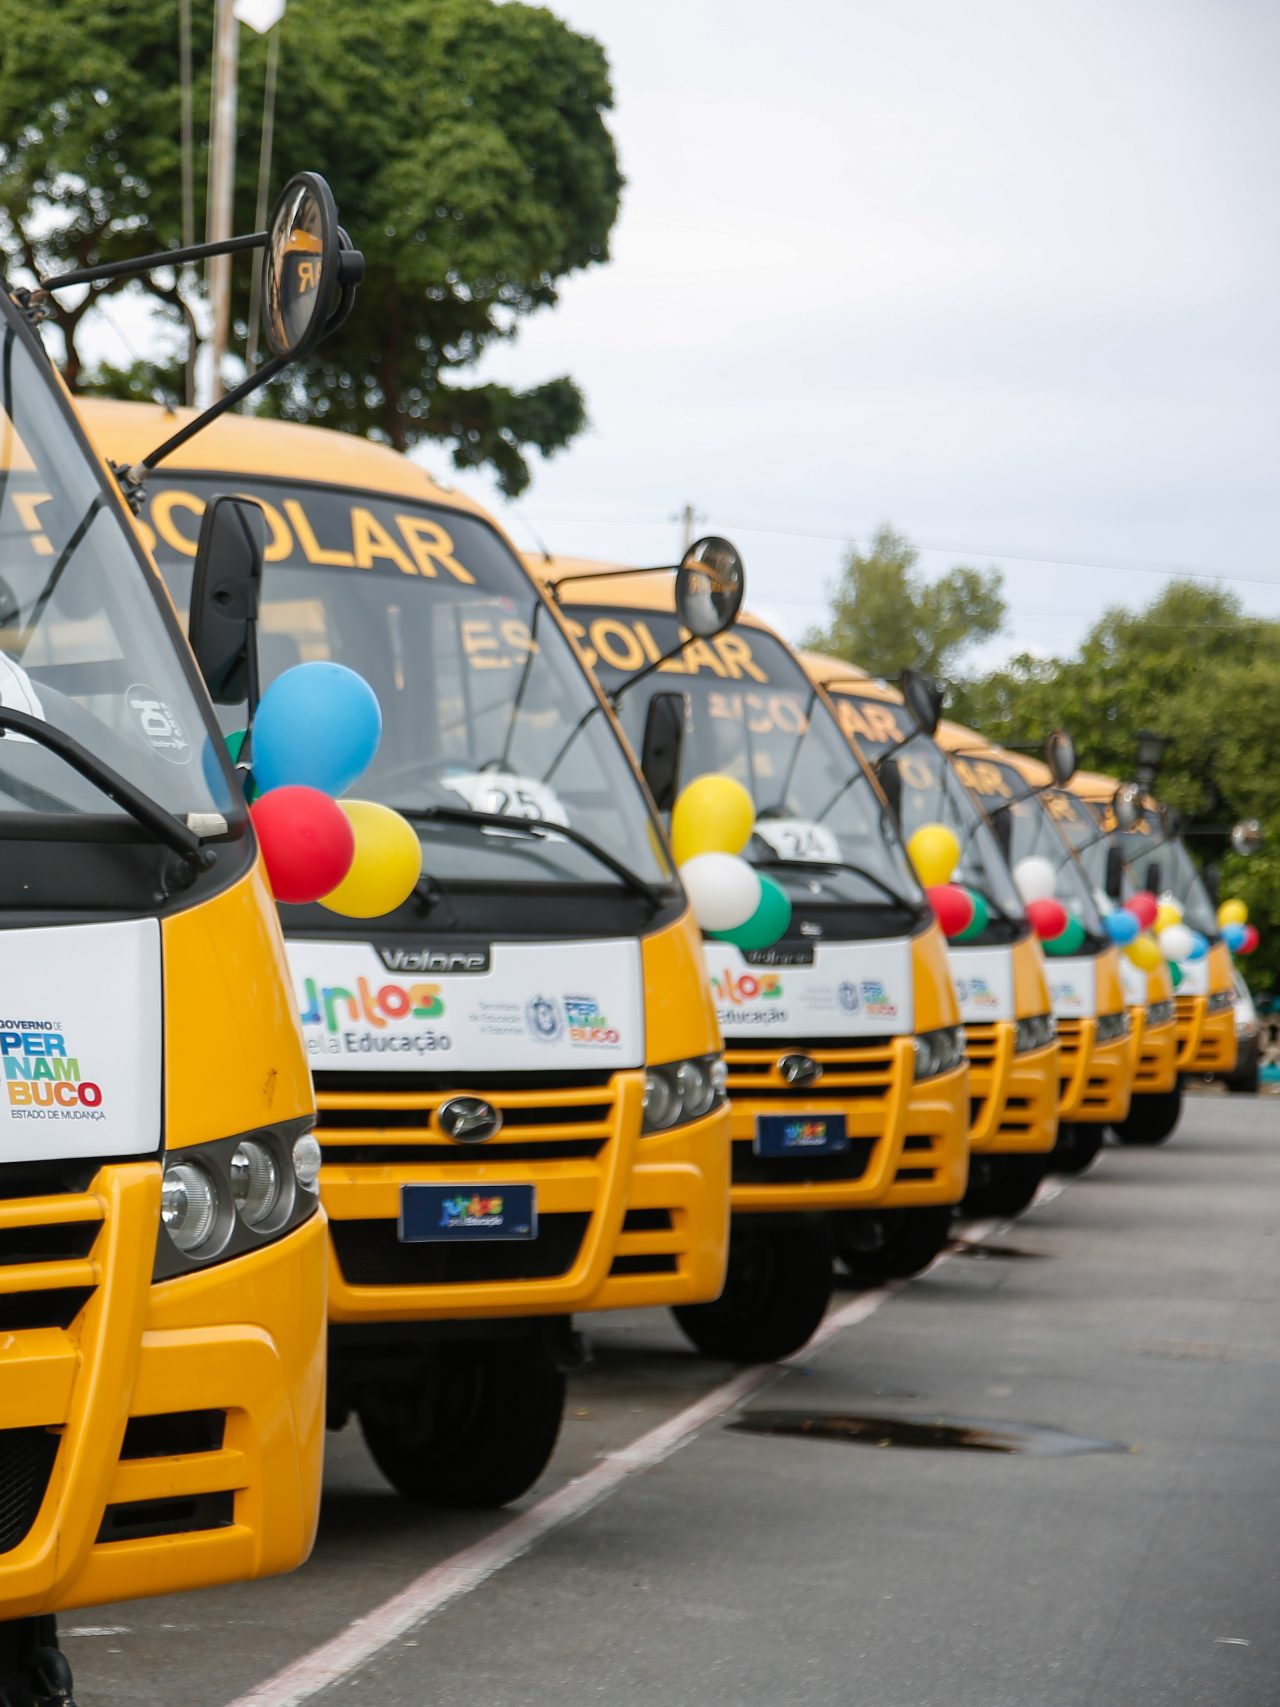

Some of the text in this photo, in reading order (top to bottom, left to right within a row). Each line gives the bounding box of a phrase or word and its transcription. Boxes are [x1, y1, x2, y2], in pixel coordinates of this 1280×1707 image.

[381, 949, 485, 971] Volare
[300, 976, 445, 1033] untos
[306, 1028, 453, 1056] ela Educação
[2, 1056, 81, 1081] NAM
[7, 1081, 103, 1108] BUCO
[11, 1110, 106, 1122] ESTADO DE MUDANÇA
